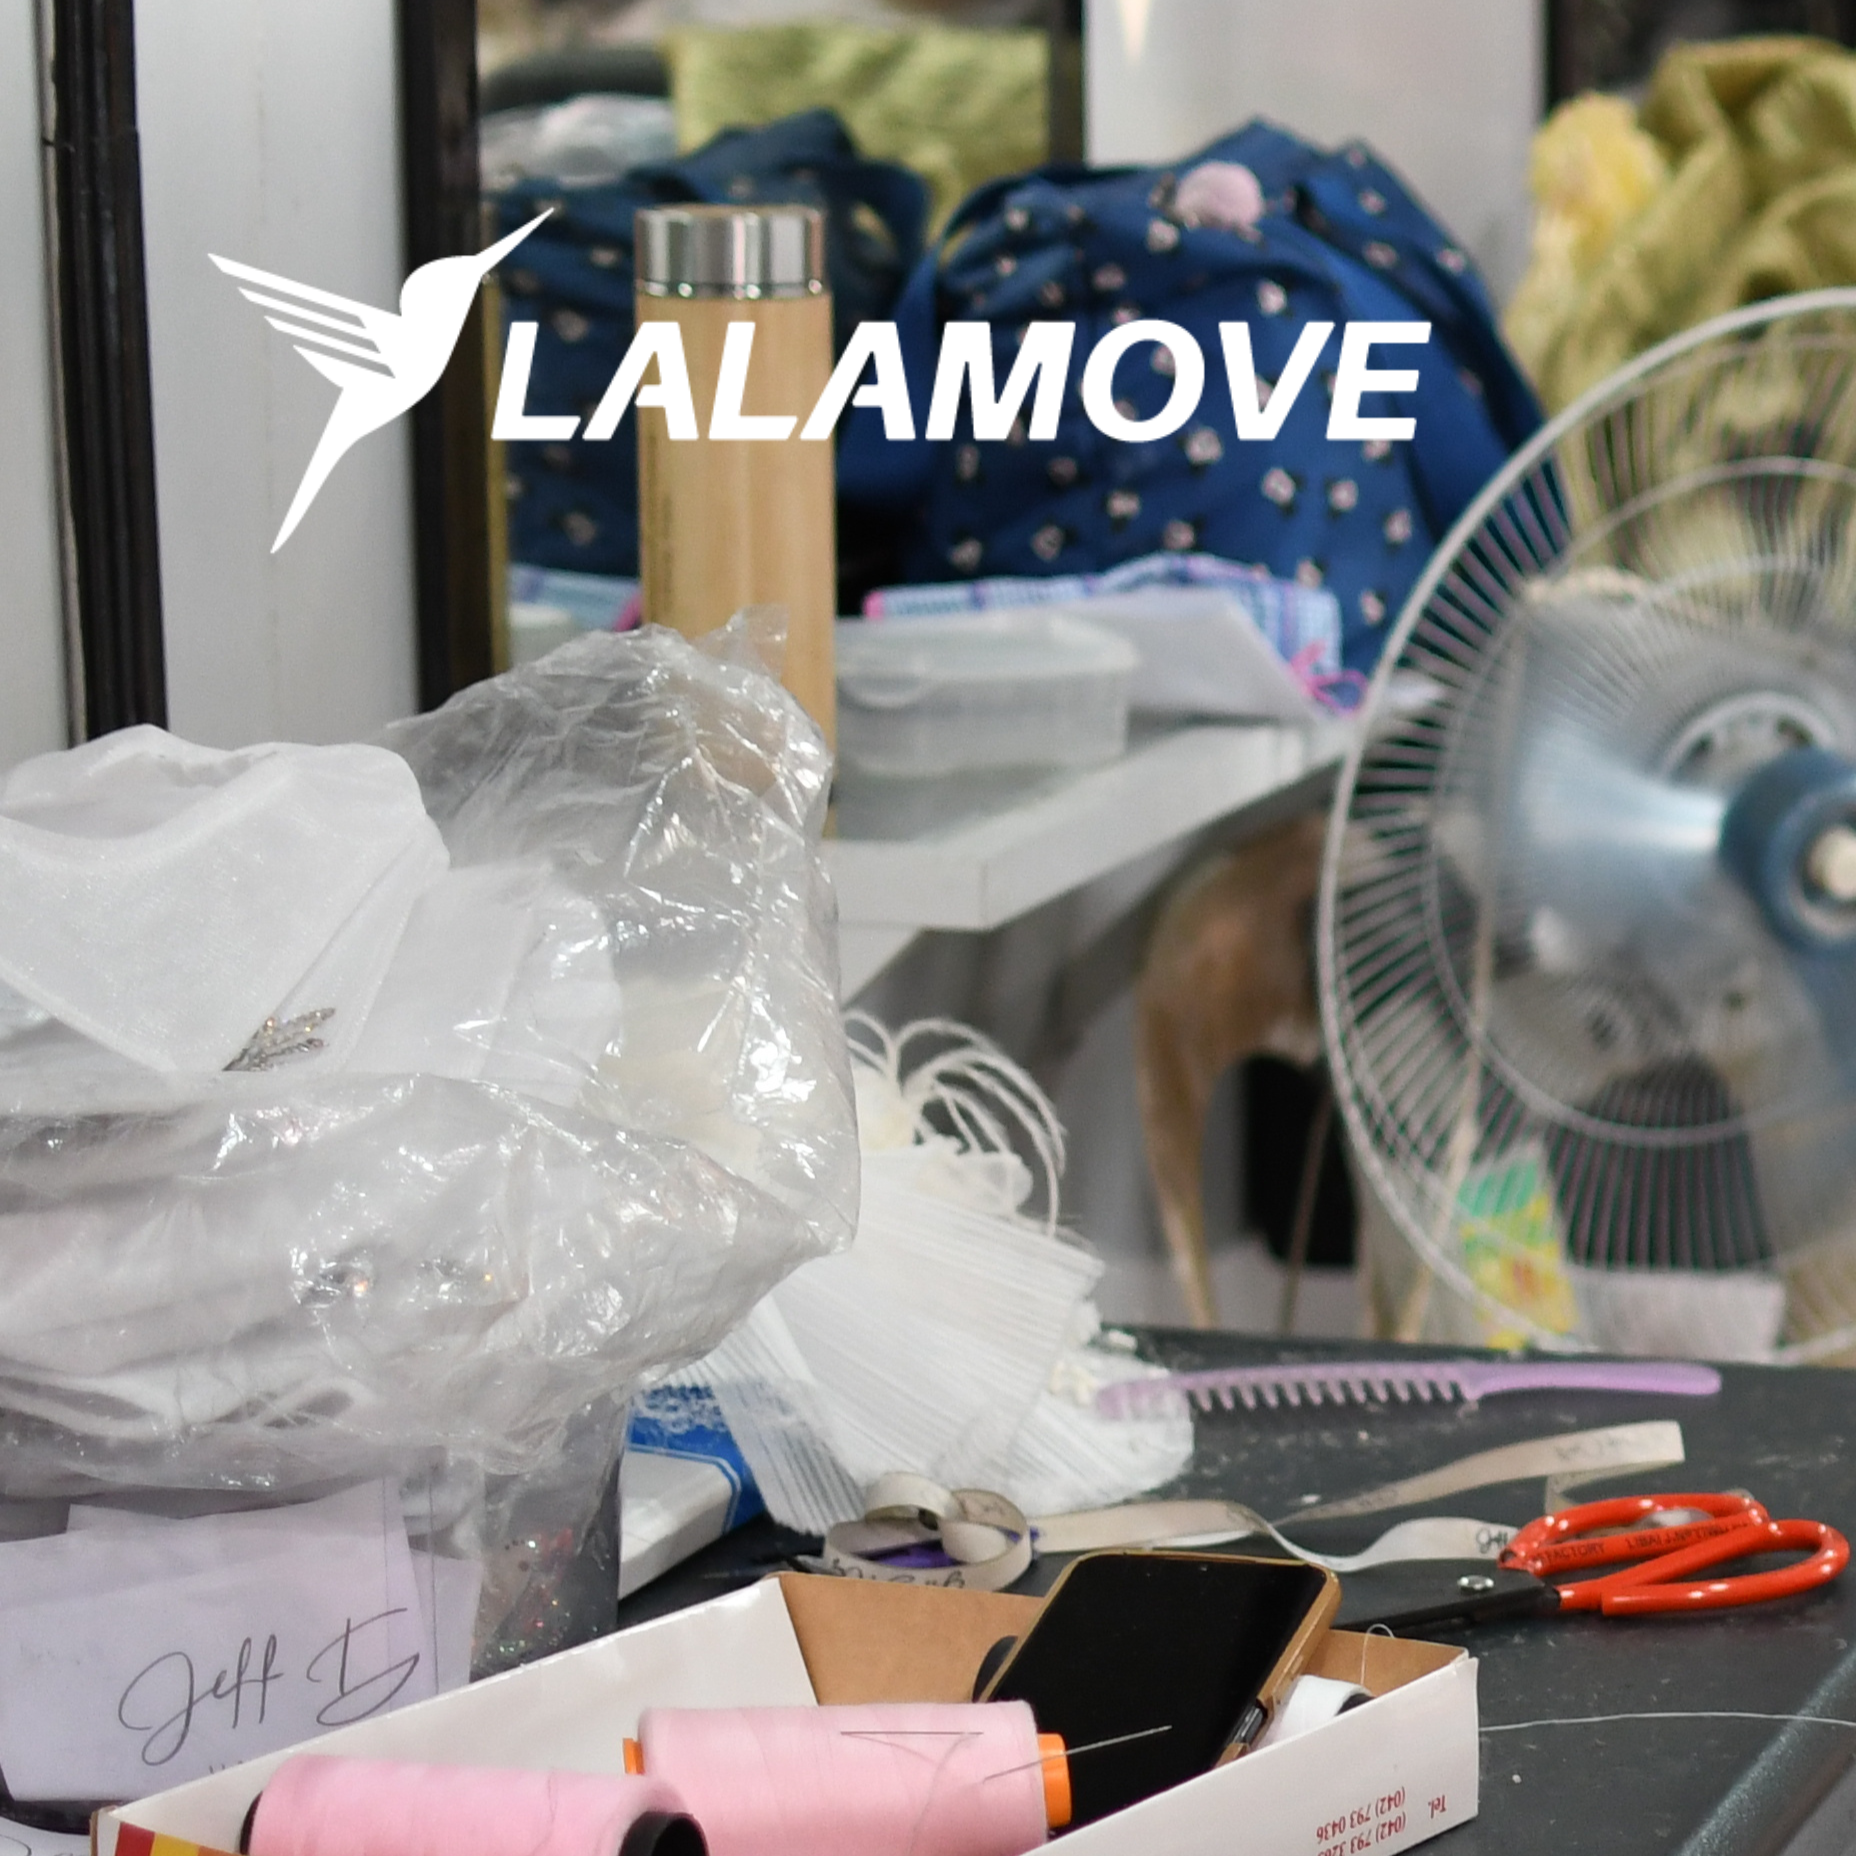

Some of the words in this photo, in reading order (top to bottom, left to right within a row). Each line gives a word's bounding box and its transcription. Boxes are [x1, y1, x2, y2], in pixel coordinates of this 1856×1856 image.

[1375, 1786, 1406, 1818] (042)
[1428, 1795, 1447, 1819] Tel.
[1350, 1804, 1371, 1829] 793
[1376, 1812, 1406, 1843] (042)
[1316, 1816, 1346, 1845] 0436
[1350, 1830, 1371, 1855] 793
